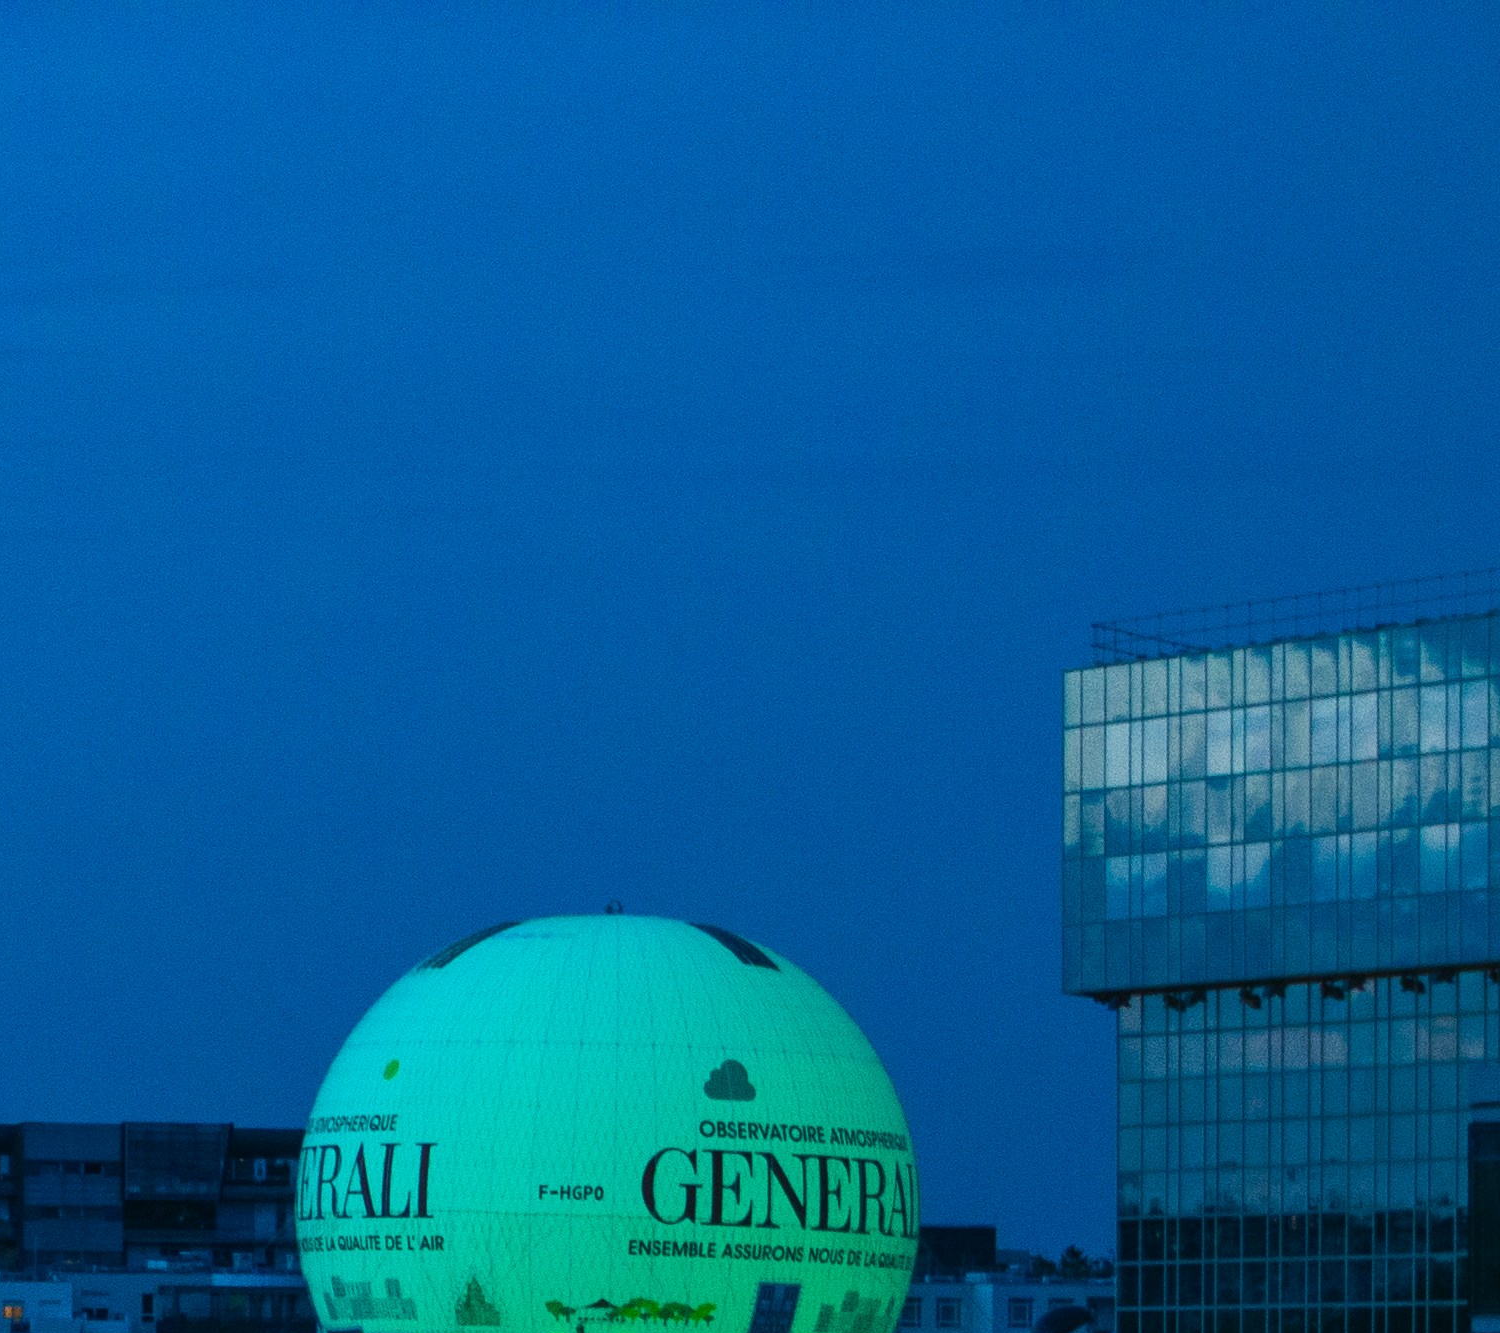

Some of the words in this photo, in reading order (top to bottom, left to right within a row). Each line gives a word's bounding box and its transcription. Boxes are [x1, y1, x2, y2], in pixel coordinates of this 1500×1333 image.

[699, 1119, 826, 1144] OBSERVATOIRE
[297, 1141, 438, 1221] ERALI
[325, 1236, 336, 1251] LA
[337, 1235, 381, 1252] QUALITE
[385, 1236, 403, 1250] DE
[420, 1235, 445, 1251] AIR
[628, 1239, 716, 1259] ENSEMBLE
[721, 1244, 804, 1263] ASSURONS
[808, 1248, 844, 1265] NOUS
[846, 1250, 862, 1267] DE
